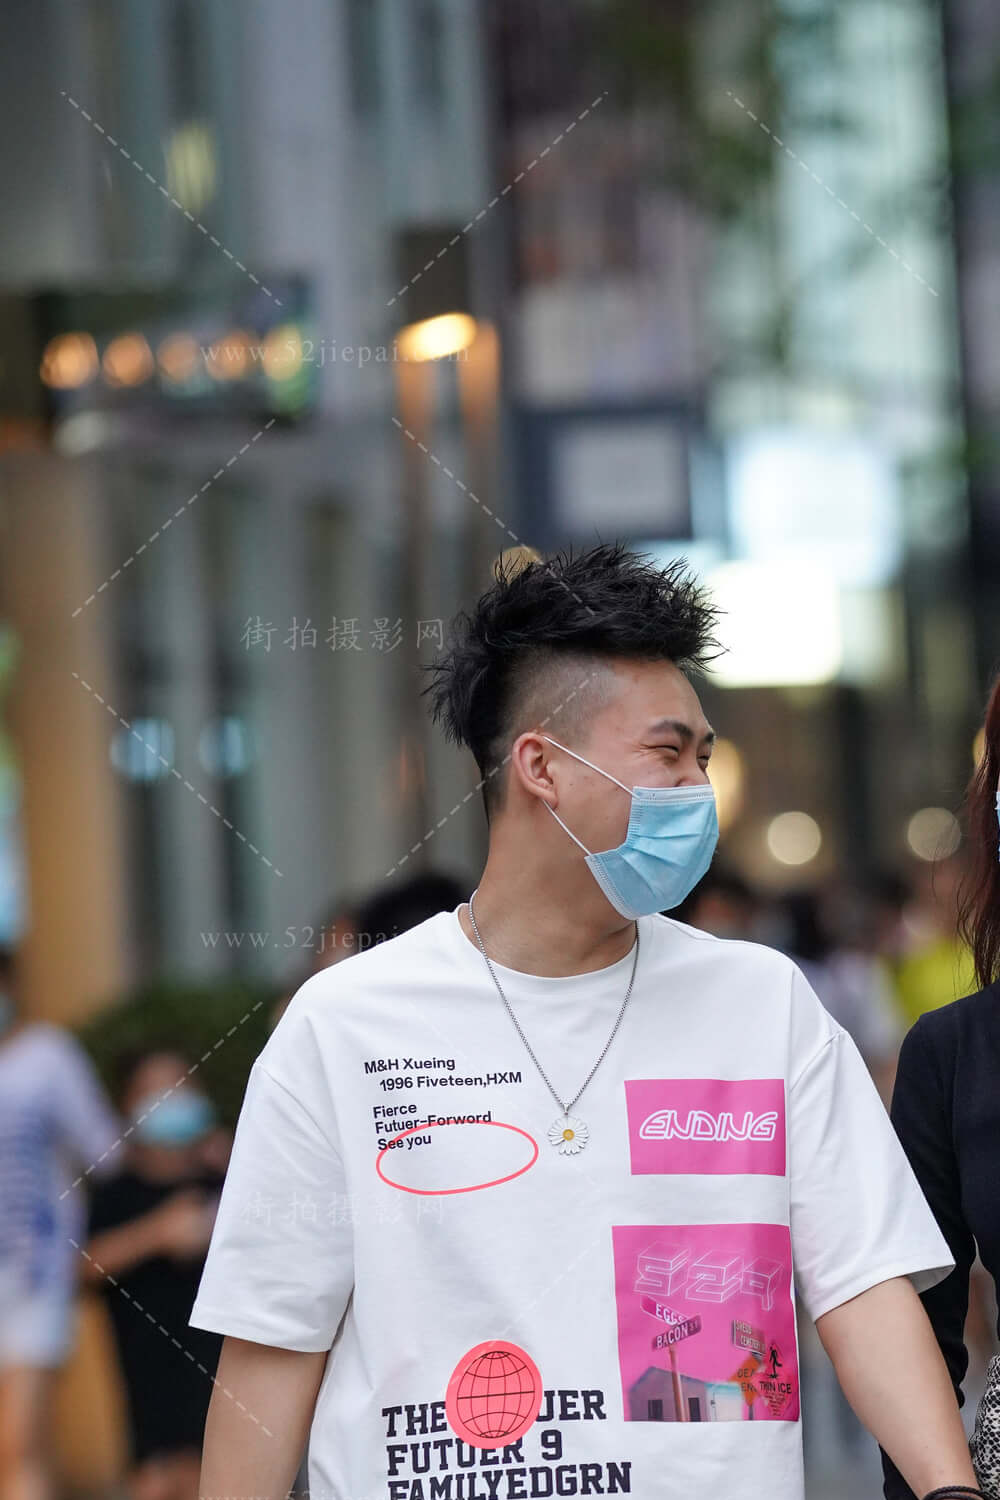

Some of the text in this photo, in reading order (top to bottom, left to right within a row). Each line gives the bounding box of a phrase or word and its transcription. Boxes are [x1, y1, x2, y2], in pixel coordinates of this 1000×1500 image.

[364, 1057, 456, 1074] M&H Xueing
[380, 1072, 523, 1091] 1996 Fiveteen,HXM
[373, 1104, 418, 1119] Fierce
[639, 1109, 779, 1142] ENDING
[377, 1134, 432, 1151] See you
[656, 1322, 689, 1349] BACON
[737, 1367, 756, 1379] DEA
[760, 1382, 793, 1395] THIN ICE
[381, 1400, 448, 1437] THE
[386, 1429, 563, 1476] FUTUER 9
